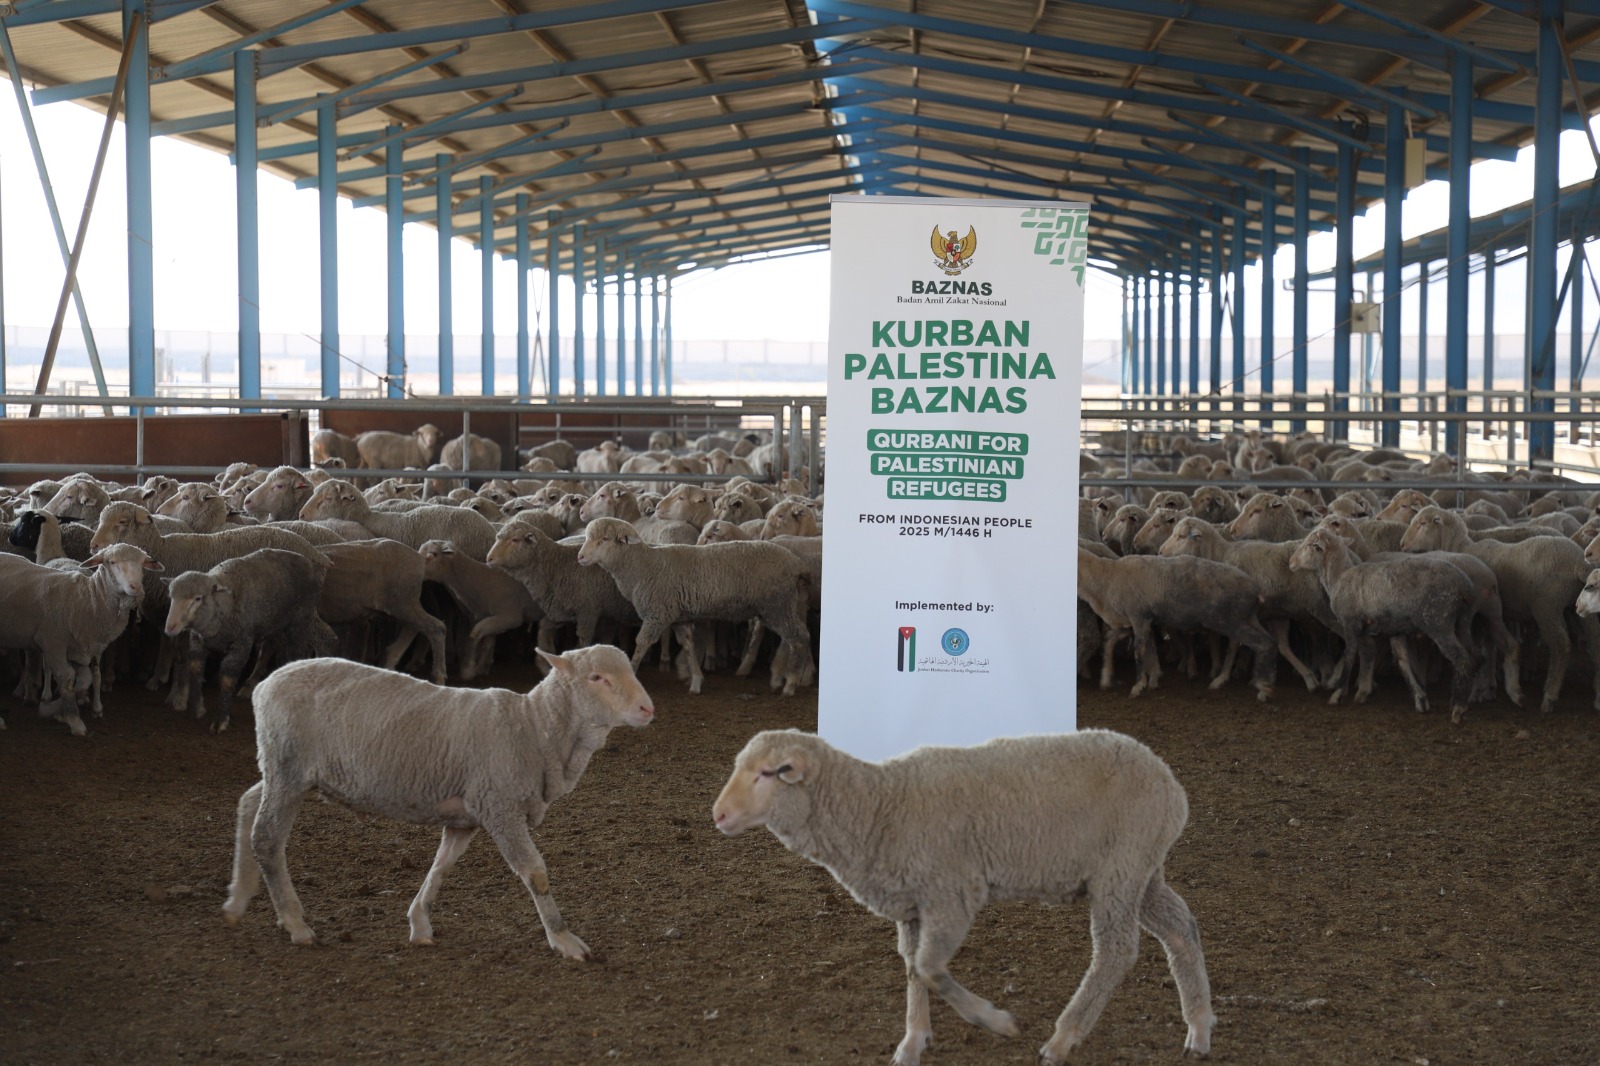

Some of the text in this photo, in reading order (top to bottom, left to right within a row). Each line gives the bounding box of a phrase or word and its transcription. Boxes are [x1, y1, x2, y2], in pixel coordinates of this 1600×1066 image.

[911, 280, 993, 296] BAZNAS
[896, 296, 923, 304] Badan
[971, 298, 1007, 306] Nasional
[872, 320, 1030, 348] KURBAN
[844, 352, 1056, 380] PALESTINA
[871, 386, 1028, 414] BAZNAS
[874, 433, 1022, 452] QURBANI FOR
[878, 457, 1016, 475] PALESTINIAN
[892, 481, 1002, 499] REFUGEES
[859, 514, 1033, 528] FROM INDONESIAN PEOPLE
[899, 526, 992, 538] 2025 M/1446 H
[895, 600, 994, 614] Implemented by:
